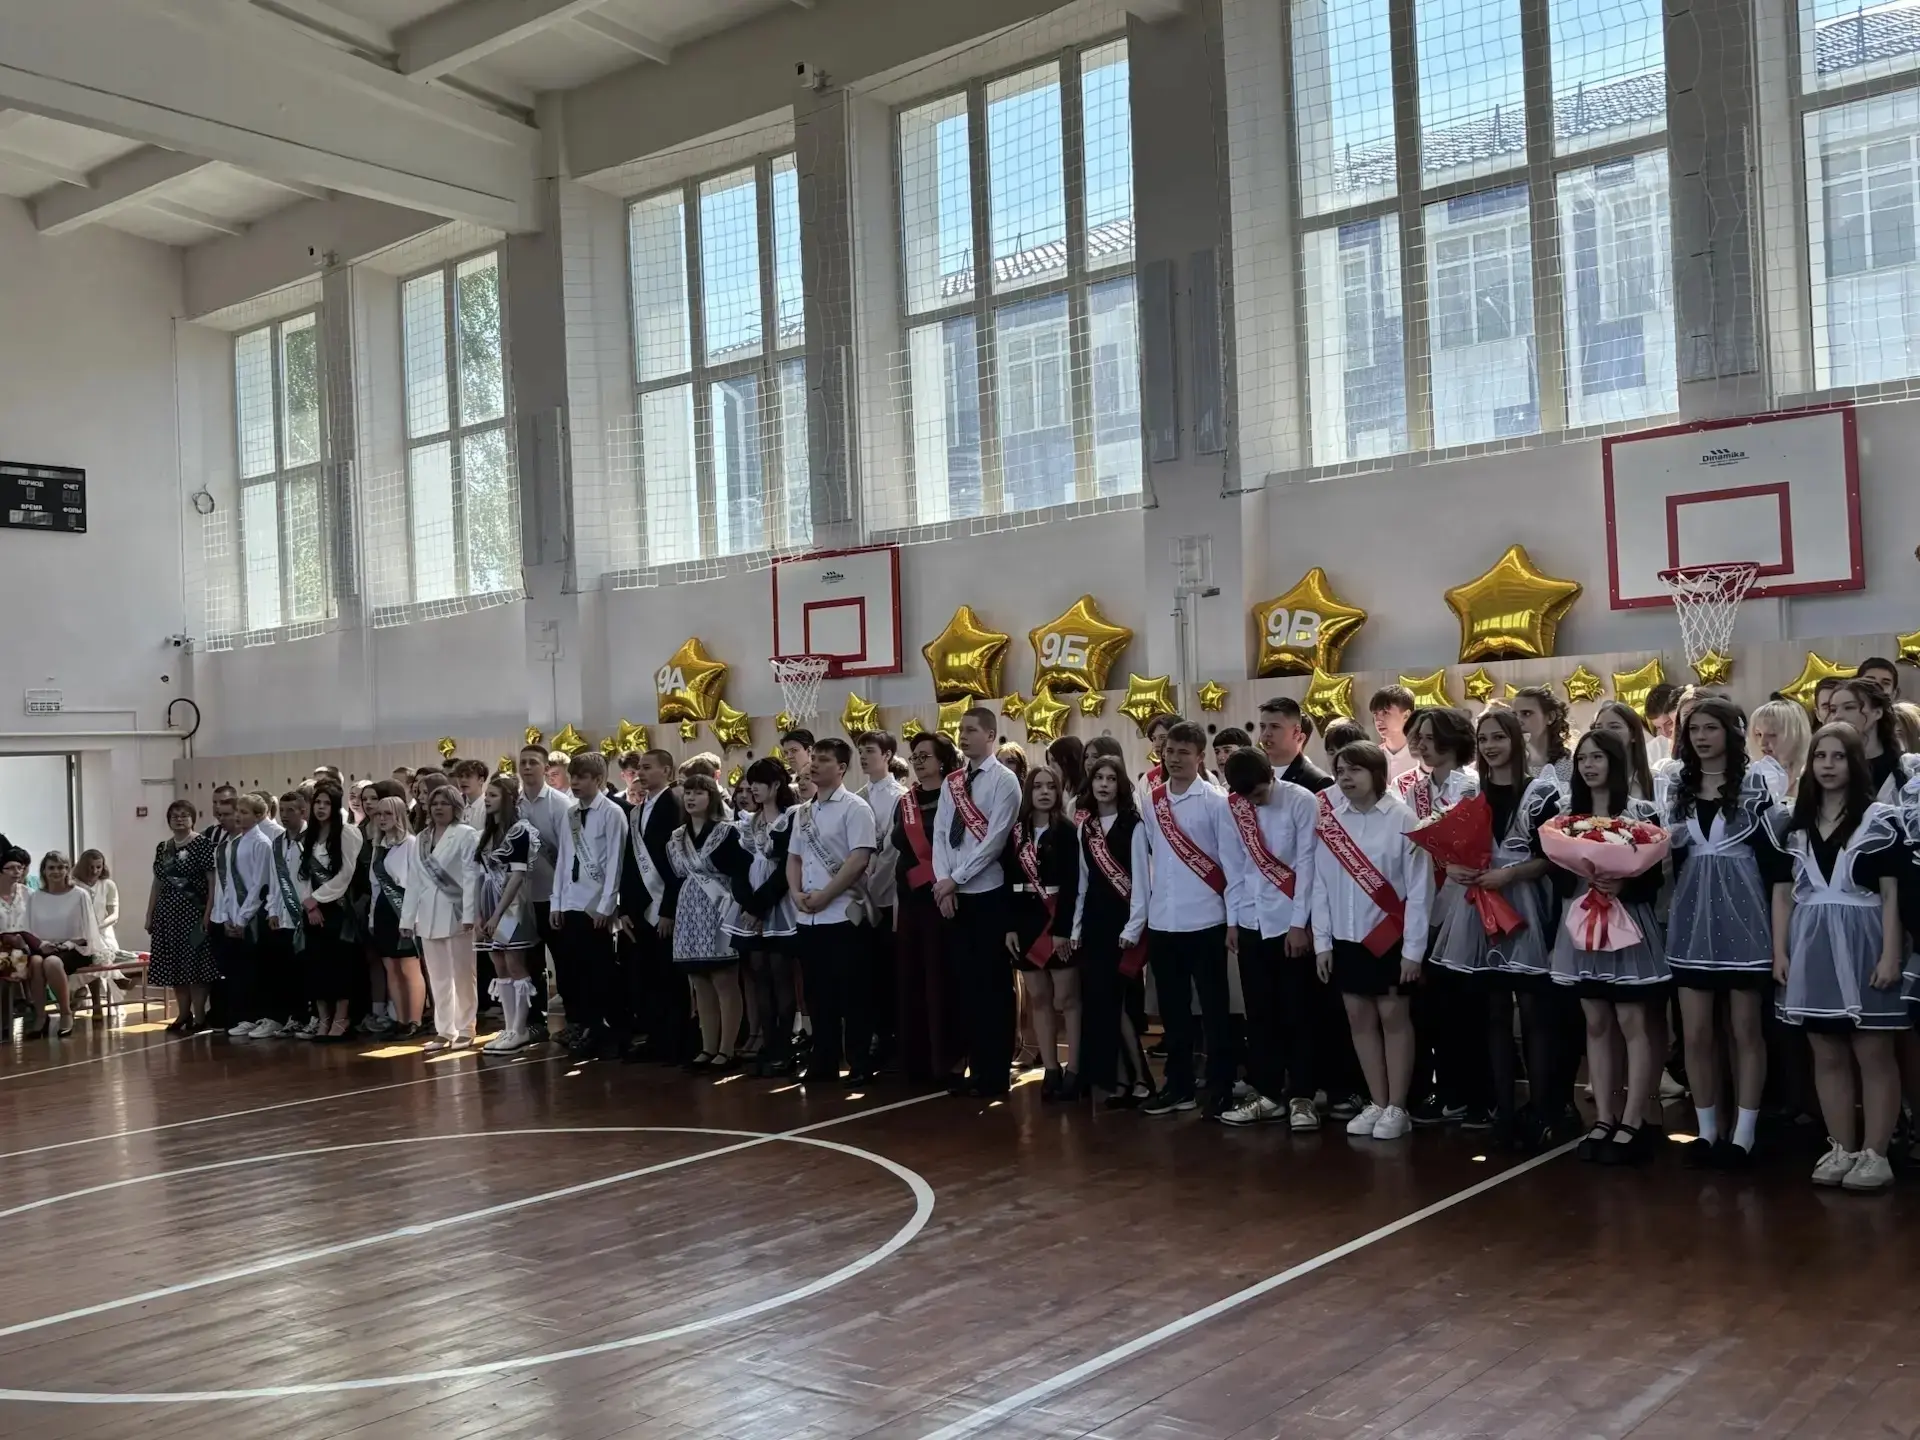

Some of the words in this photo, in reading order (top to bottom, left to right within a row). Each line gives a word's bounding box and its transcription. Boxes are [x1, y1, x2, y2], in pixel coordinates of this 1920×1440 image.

[1702, 450, 1745, 462] Dinamika
[18, 479, 44, 488] ПЕРИОД
[21, 503, 43, 511] ВРЕМЯ
[1267, 607, 1321, 648] 9В
[1040, 632, 1088, 669] 9Б
[657, 664, 686, 695] 9А
